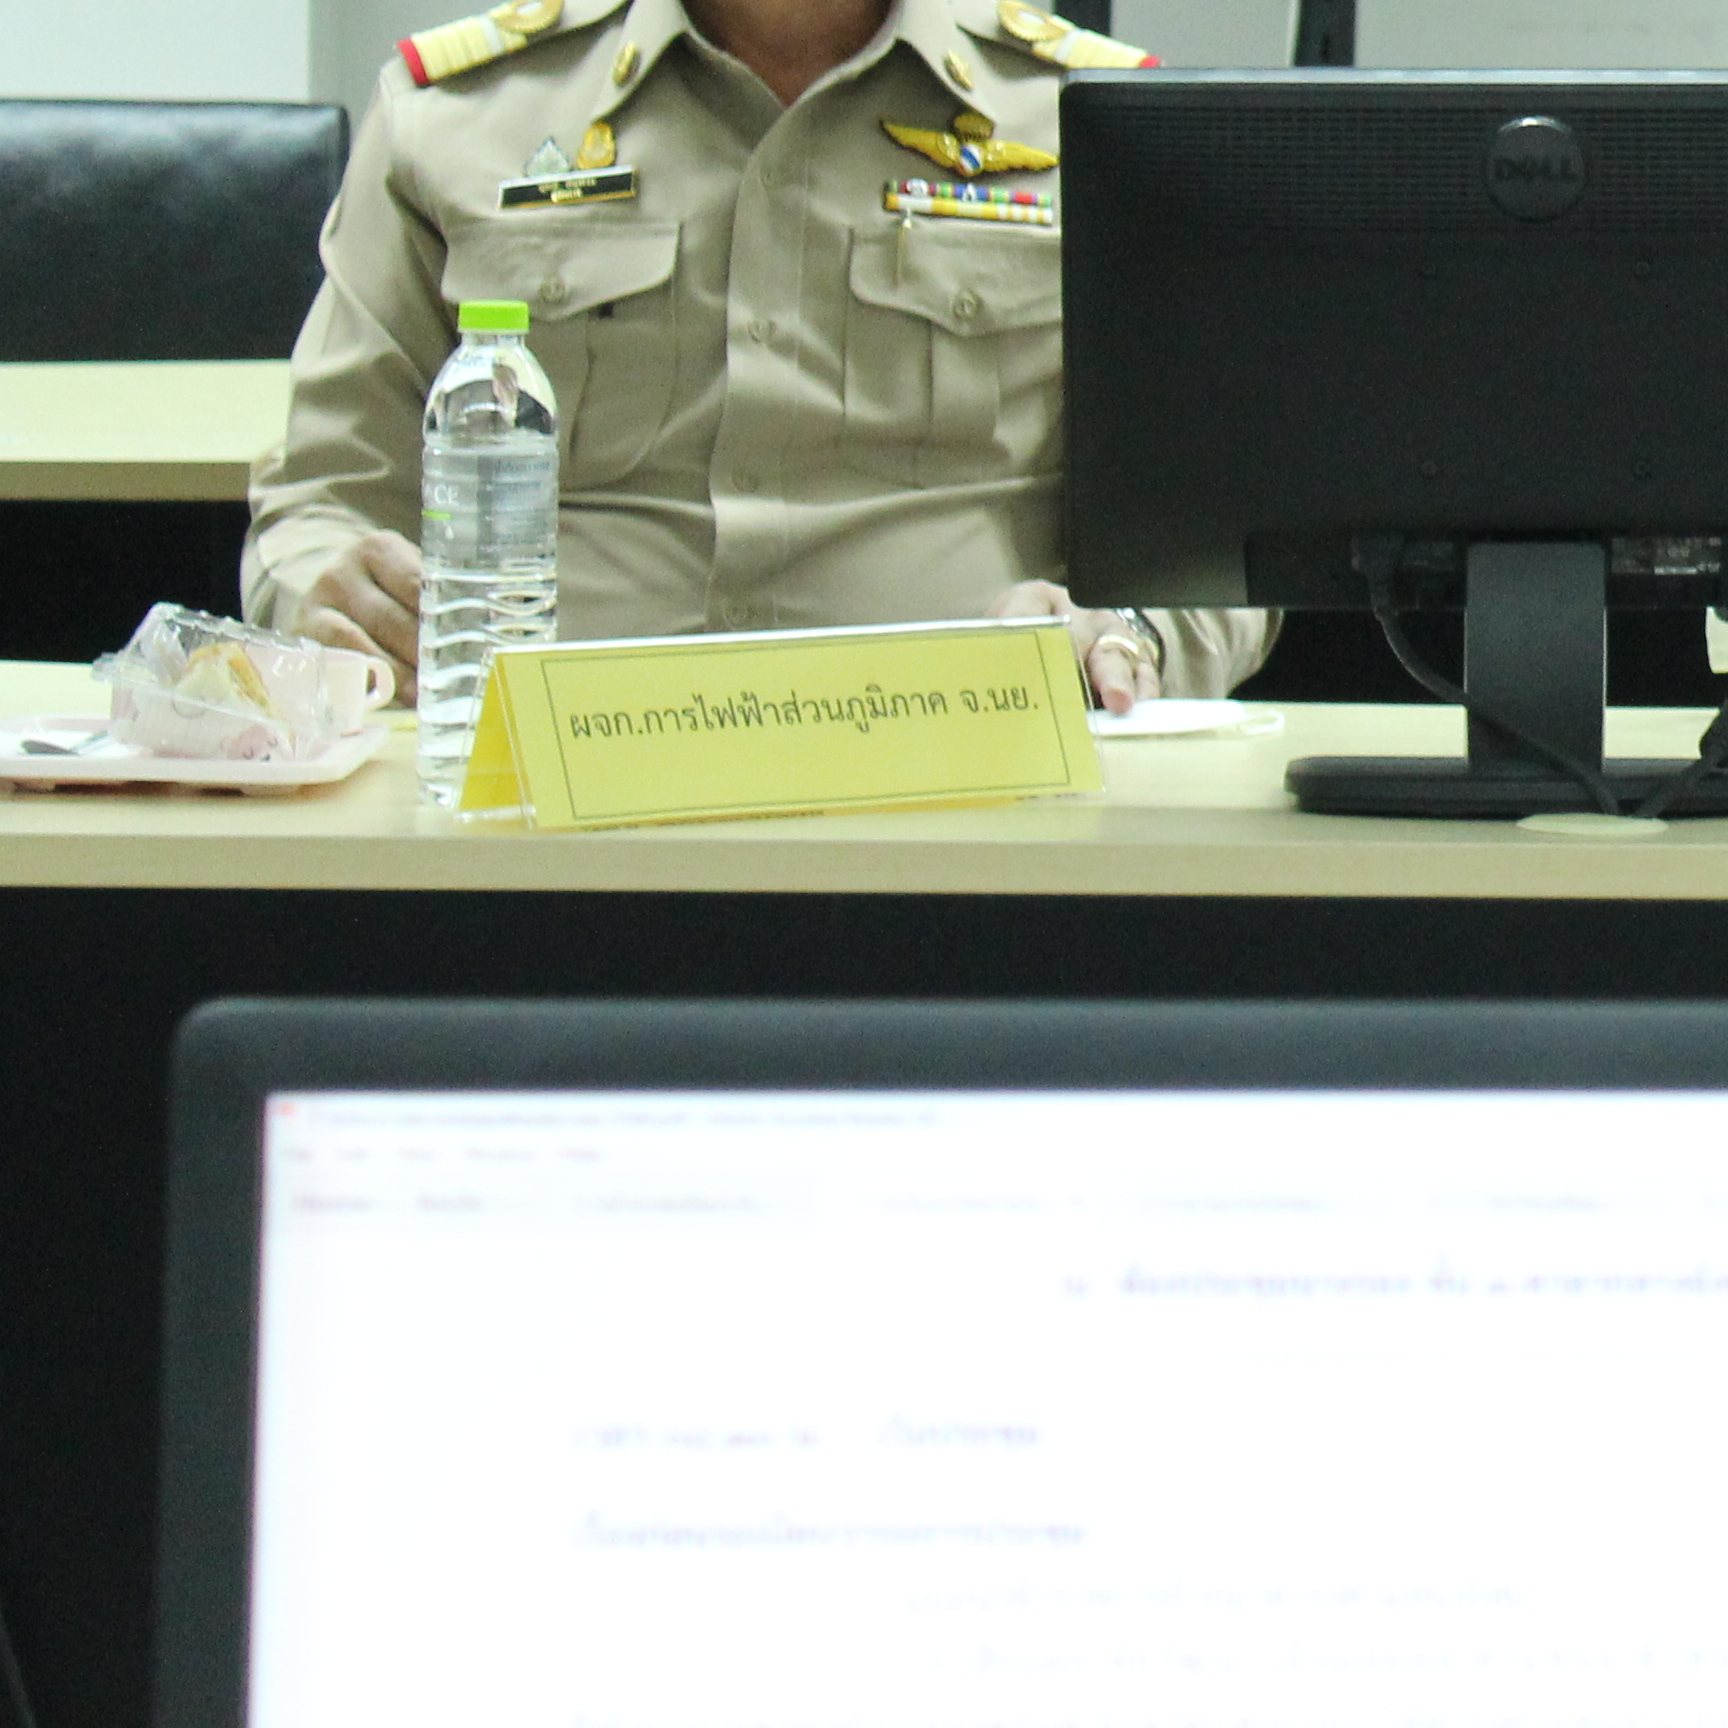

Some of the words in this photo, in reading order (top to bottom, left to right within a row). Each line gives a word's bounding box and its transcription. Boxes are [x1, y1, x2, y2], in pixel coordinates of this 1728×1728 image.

[1494, 156, 1578, 183] DELL
[569, 684, 949, 739] ผจก.การไฟฟ้าส่วนภูมิภาค
[960, 684, 1039, 714] จ.นย.
